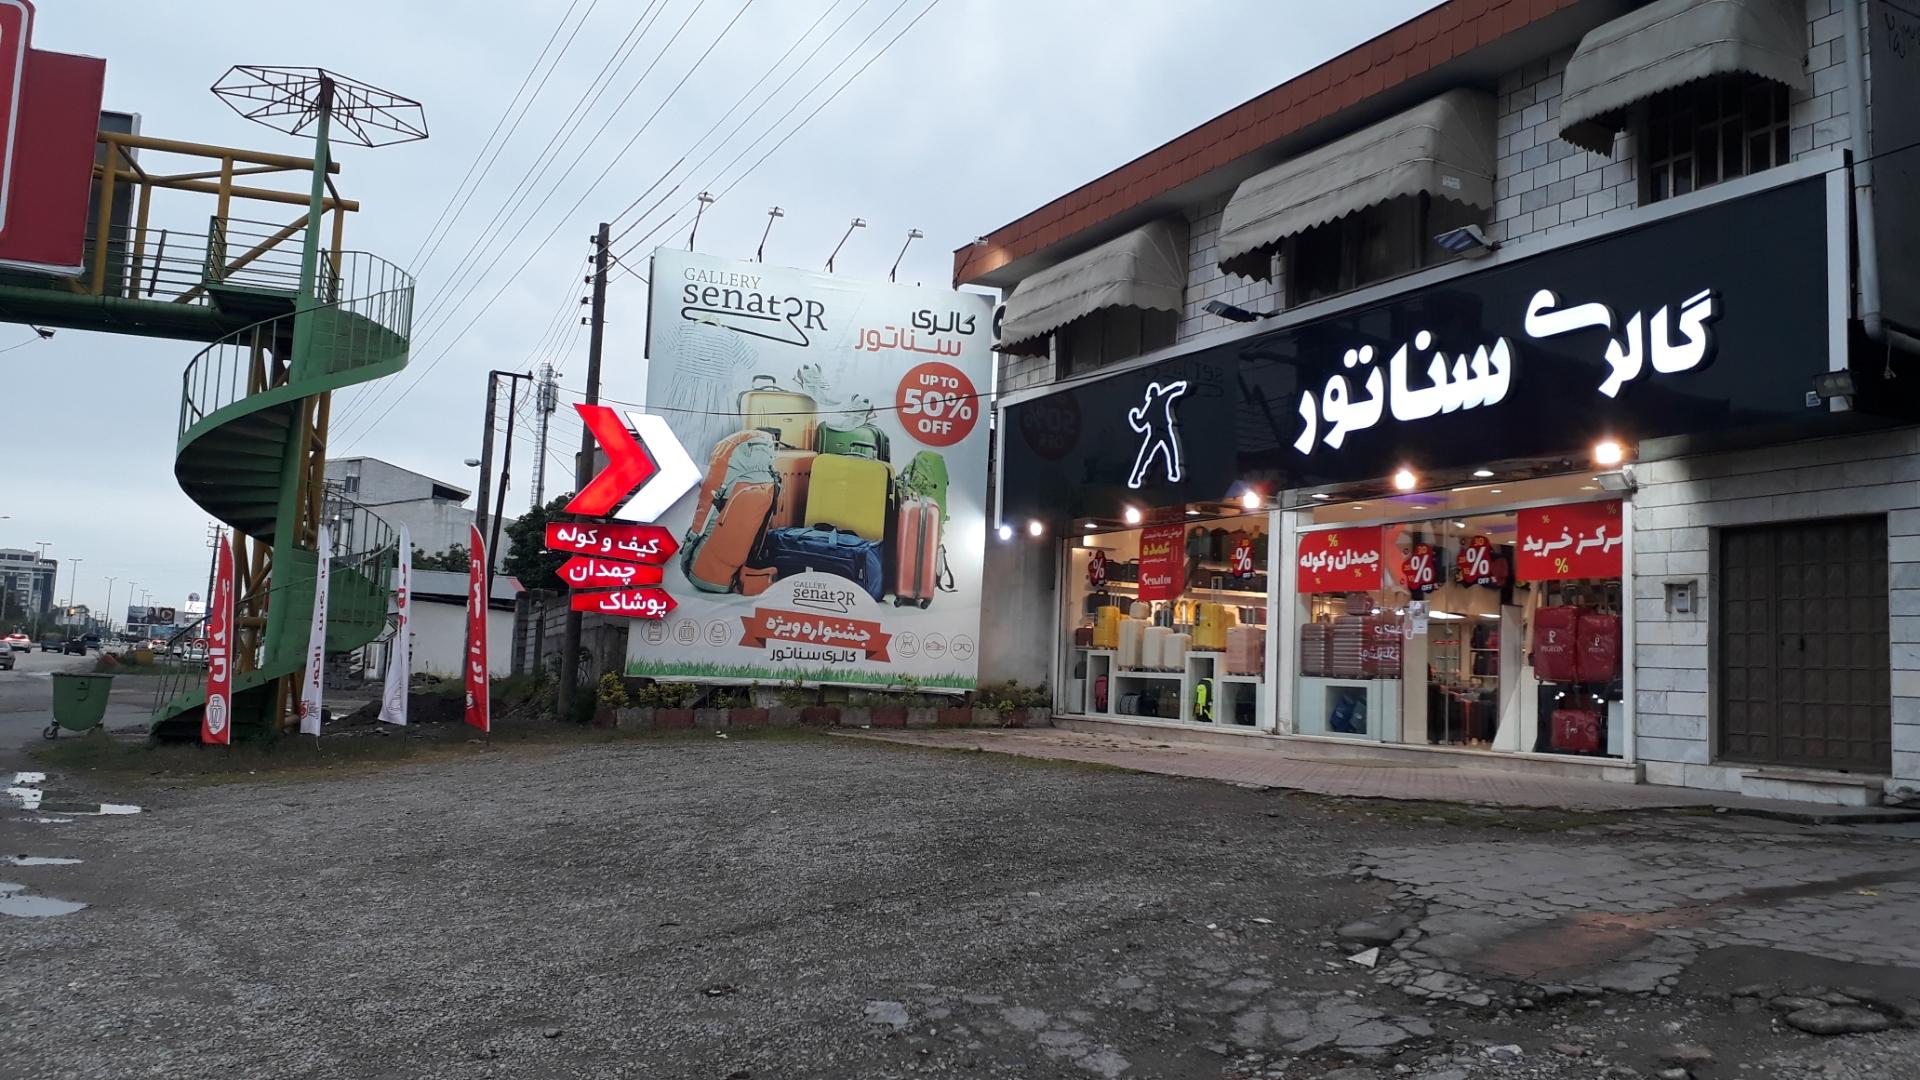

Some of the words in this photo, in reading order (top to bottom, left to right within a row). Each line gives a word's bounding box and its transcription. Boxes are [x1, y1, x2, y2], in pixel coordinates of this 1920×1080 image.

[684, 267, 762, 289] GALLERY
[855, 325, 963, 357] سناتور
[1524, 287, 1712, 399] گالری
[919, 373, 939, 386] UP
[939, 377, 959, 389] TO
[1293, 329, 1512, 455] سناتور
[902, 388, 972, 420] 50%
[917, 419, 953, 435] OFF
[556, 527, 598, 548] کوله
[601, 537, 612, 552] و
[618, 536, 660, 557] کیف
[1523, 526, 1573, 558] خرید
[1300, 550, 1327, 573] کوله
[1327, 554, 1334, 573] و
[1335, 548, 1380, 572] چمدان
[569, 559, 636, 585] چمدان
[599, 592, 667, 618] پوشاک
[766, 615, 801, 638] ویژه
[802, 619, 871, 647] جشنواره
[770, 647, 821, 662] سناتور
